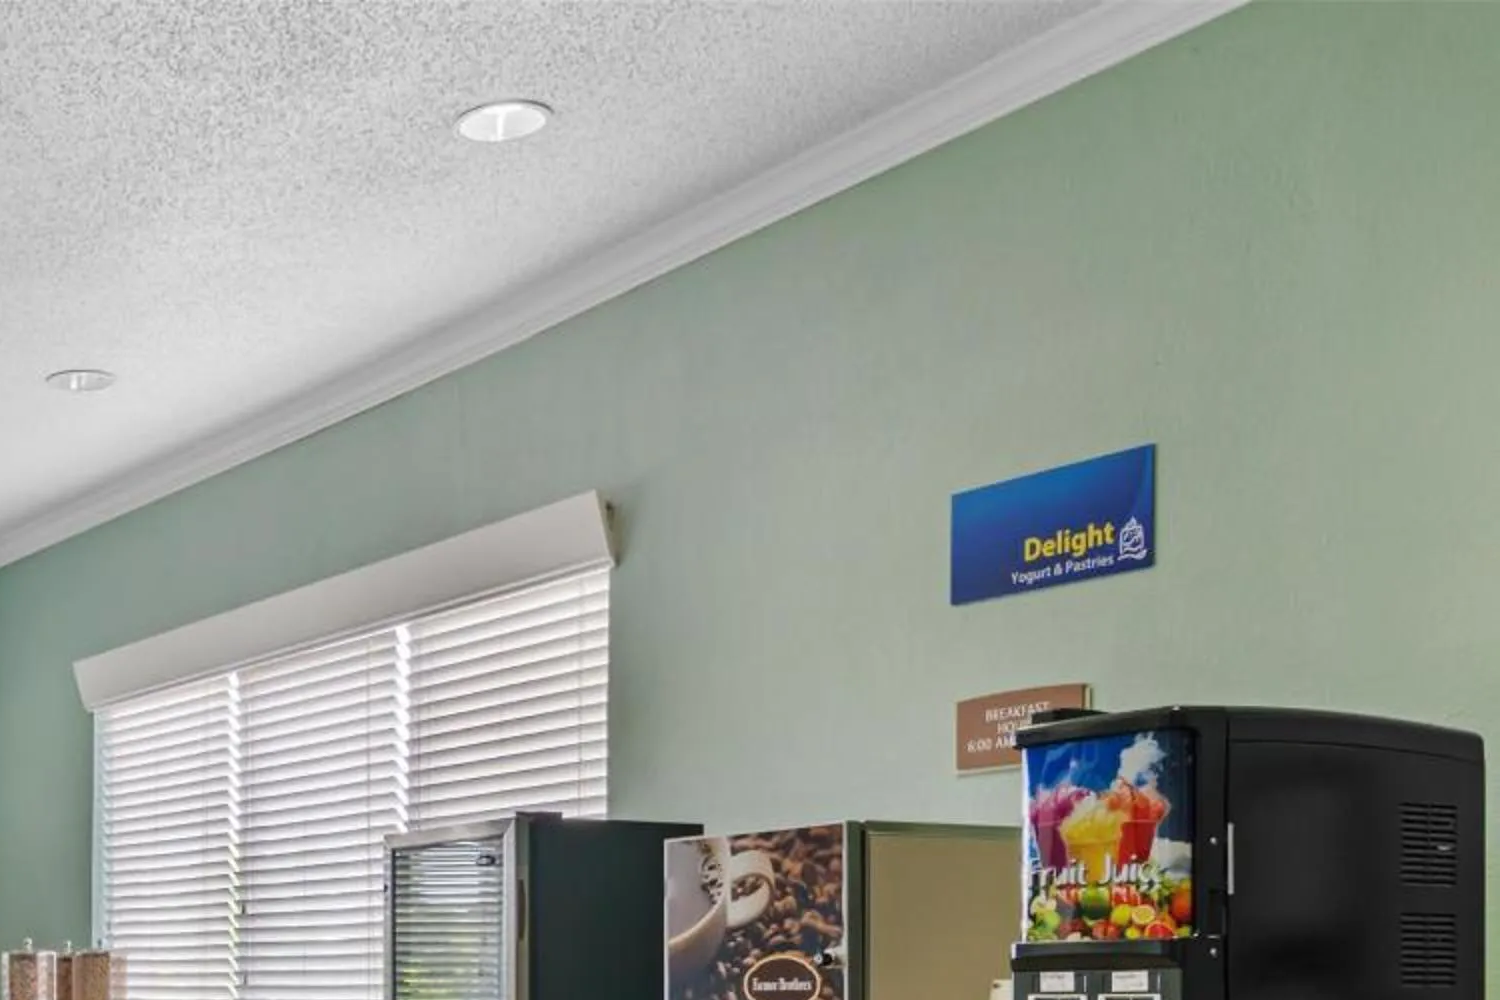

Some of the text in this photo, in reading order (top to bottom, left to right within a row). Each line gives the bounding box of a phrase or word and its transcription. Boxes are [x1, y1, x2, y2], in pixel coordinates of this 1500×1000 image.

[1024, 522, 1114, 562] Delight
[1011, 555, 1114, 584] Yogurt & Pastries
[984, 701, 1049, 723] BREAKFAST
